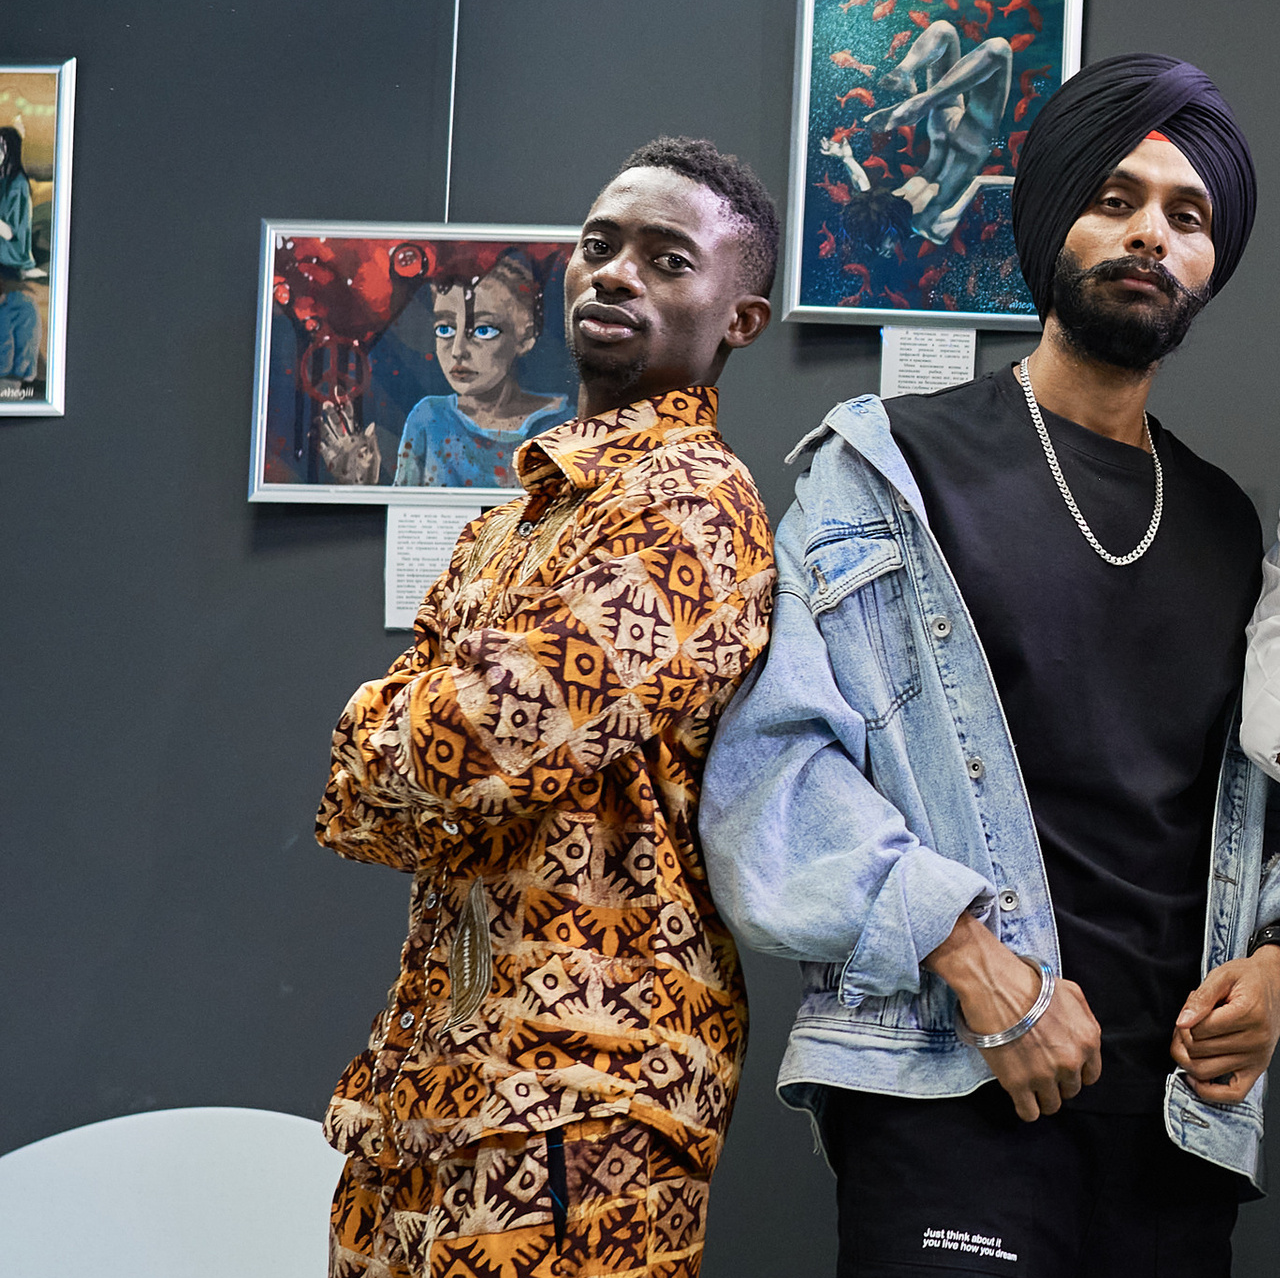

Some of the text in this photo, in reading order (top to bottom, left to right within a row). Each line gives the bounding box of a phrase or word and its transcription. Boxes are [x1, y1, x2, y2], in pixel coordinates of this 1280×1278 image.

[923, 1228, 1002, 1248] Just think about it
[922, 1238, 1018, 1261] you live how you dream
